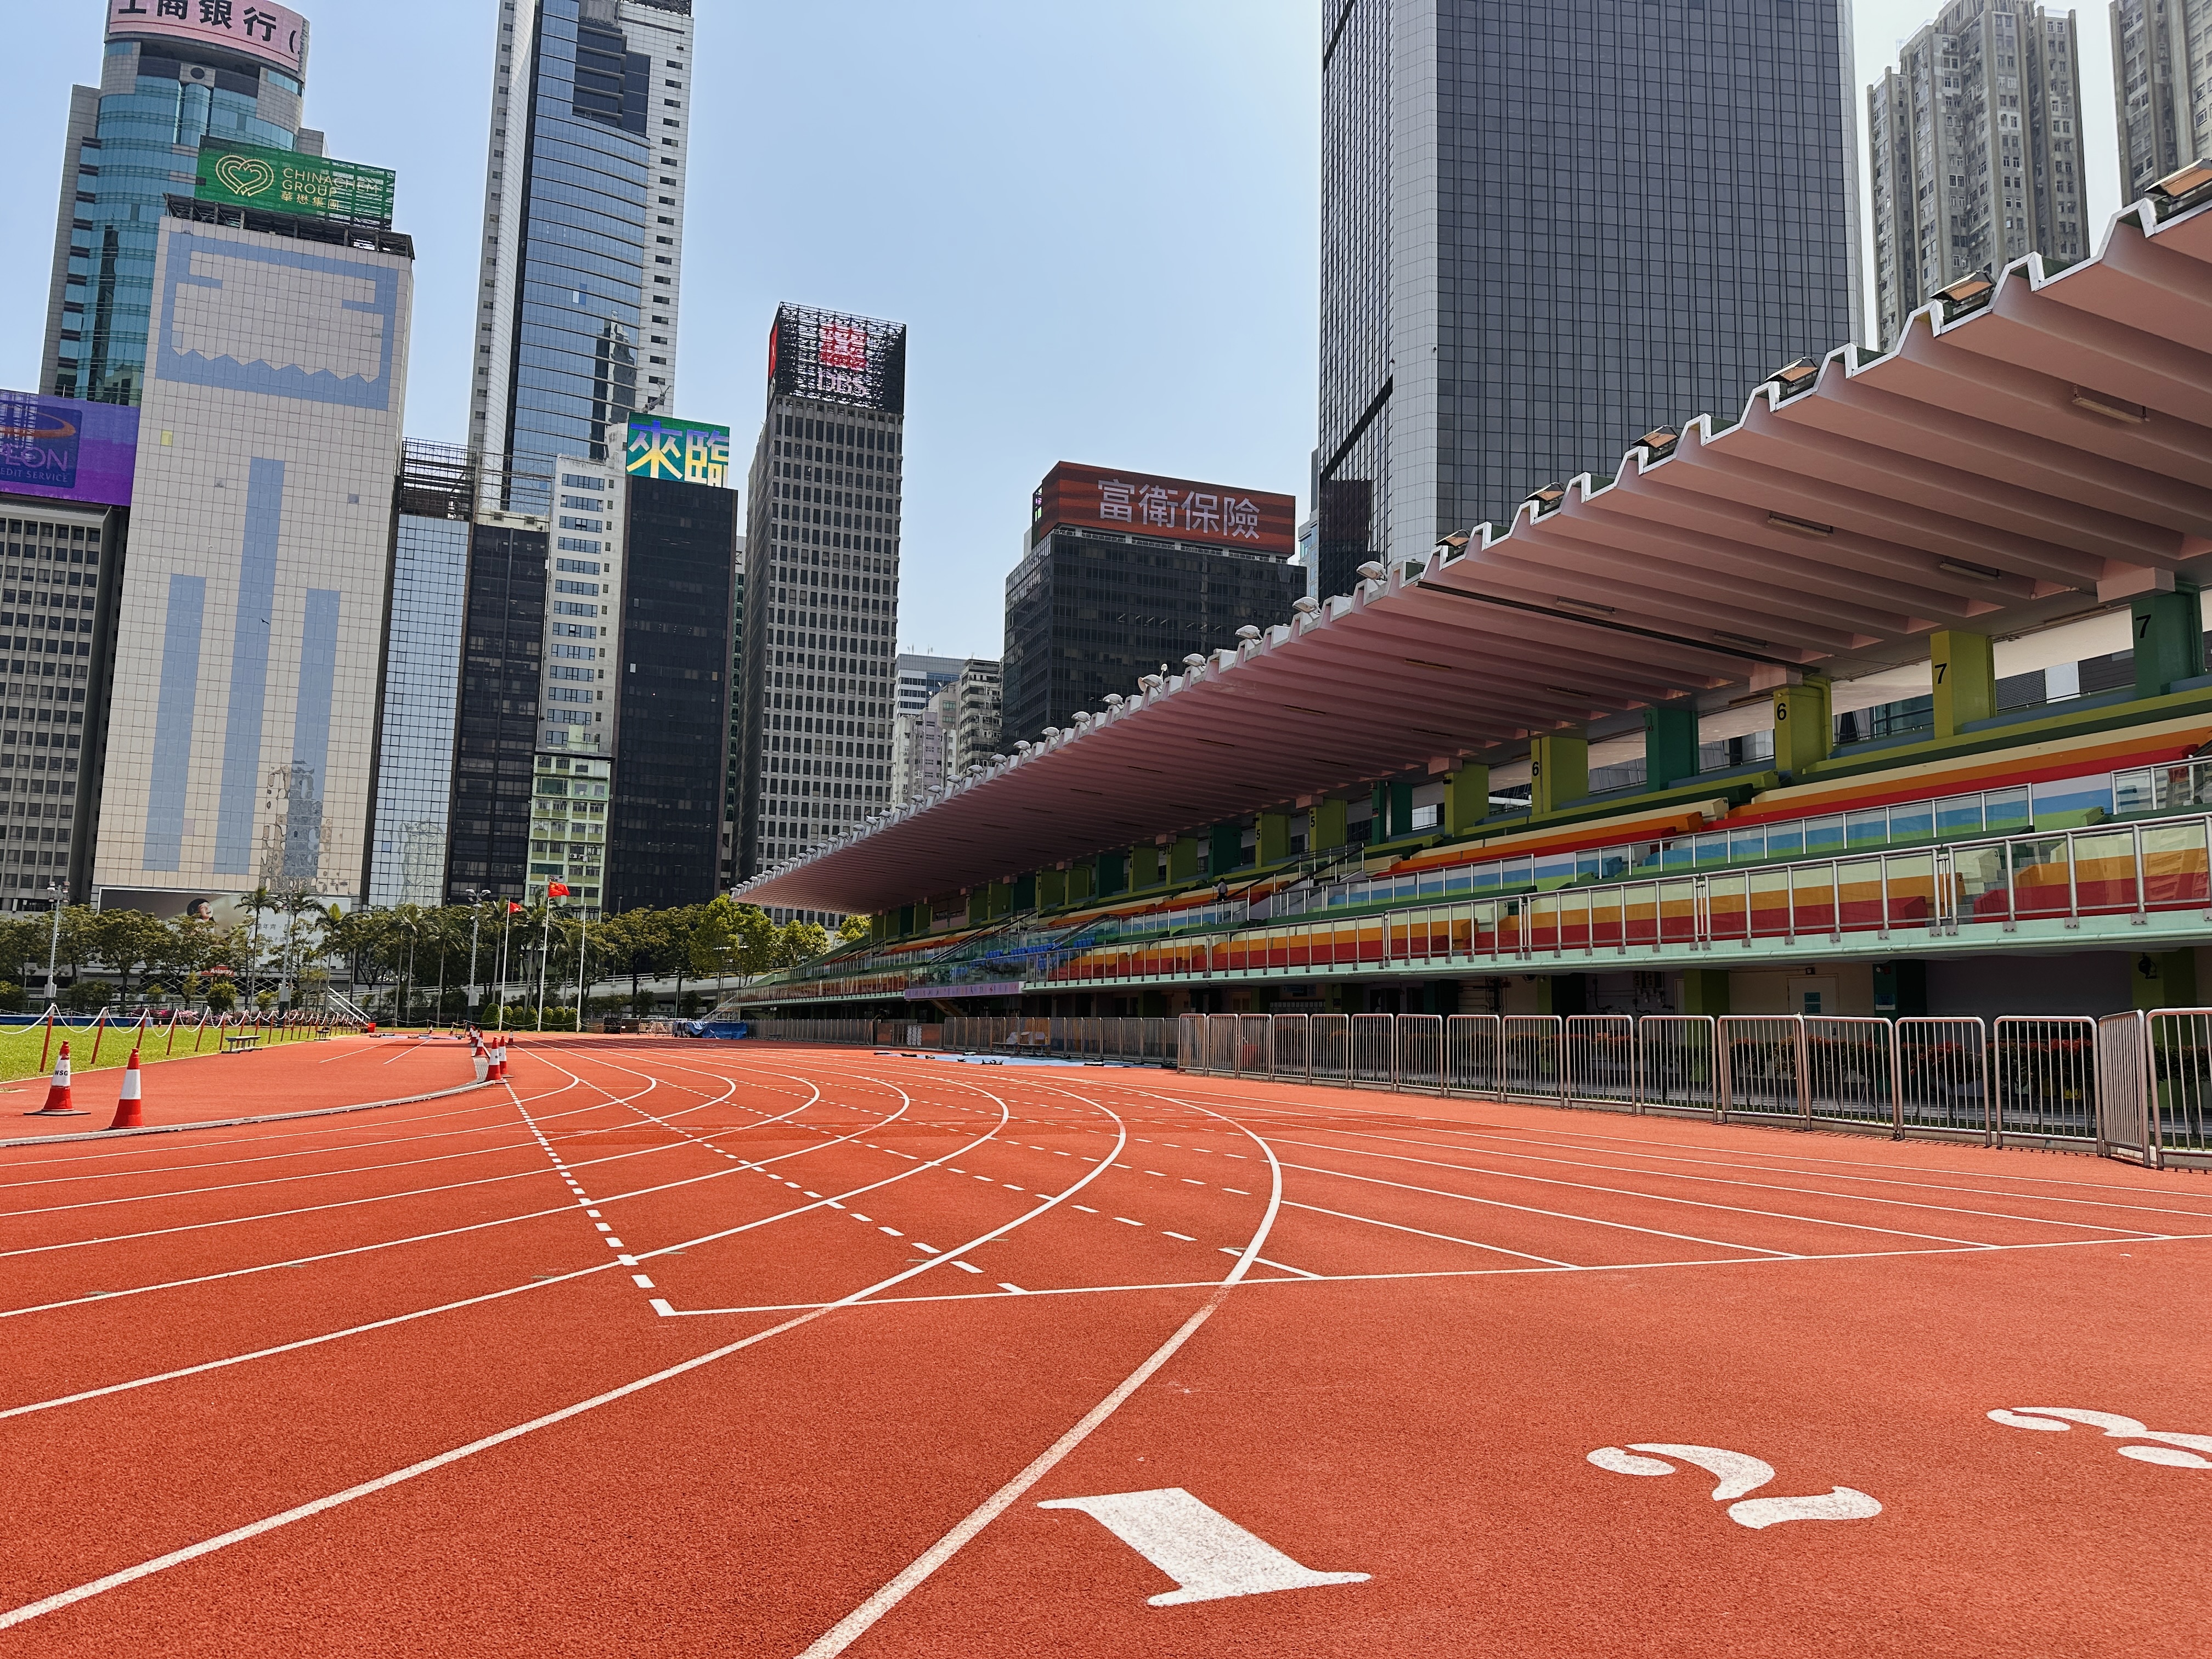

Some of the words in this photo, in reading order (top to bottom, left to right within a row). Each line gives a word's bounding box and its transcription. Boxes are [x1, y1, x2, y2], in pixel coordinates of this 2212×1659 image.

[118, 0, 300, 54] 工商銀行(
[281, 179, 338, 198] GROUP
[283, 167, 379, 194] CHINACHEM
[280, 190, 339, 210] 華懋集團
[816, 369, 867, 397] DBS
[626, 419, 729, 488] 來臨
[26, 470, 68, 483] SERVICE
[1097, 478, 1261, 540] 富衛保險
[2135, 614, 2152, 639] 7
[1934, 662, 1948, 685] 7
[1776, 702, 1787, 721] 6
[1532, 761, 1539, 776] 6
[1310, 816, 1315, 828] 5
[1256, 829, 1261, 840] 5
[1586, 1442, 1883, 1530] 2
[1037, 1487, 1372, 1606] 1
